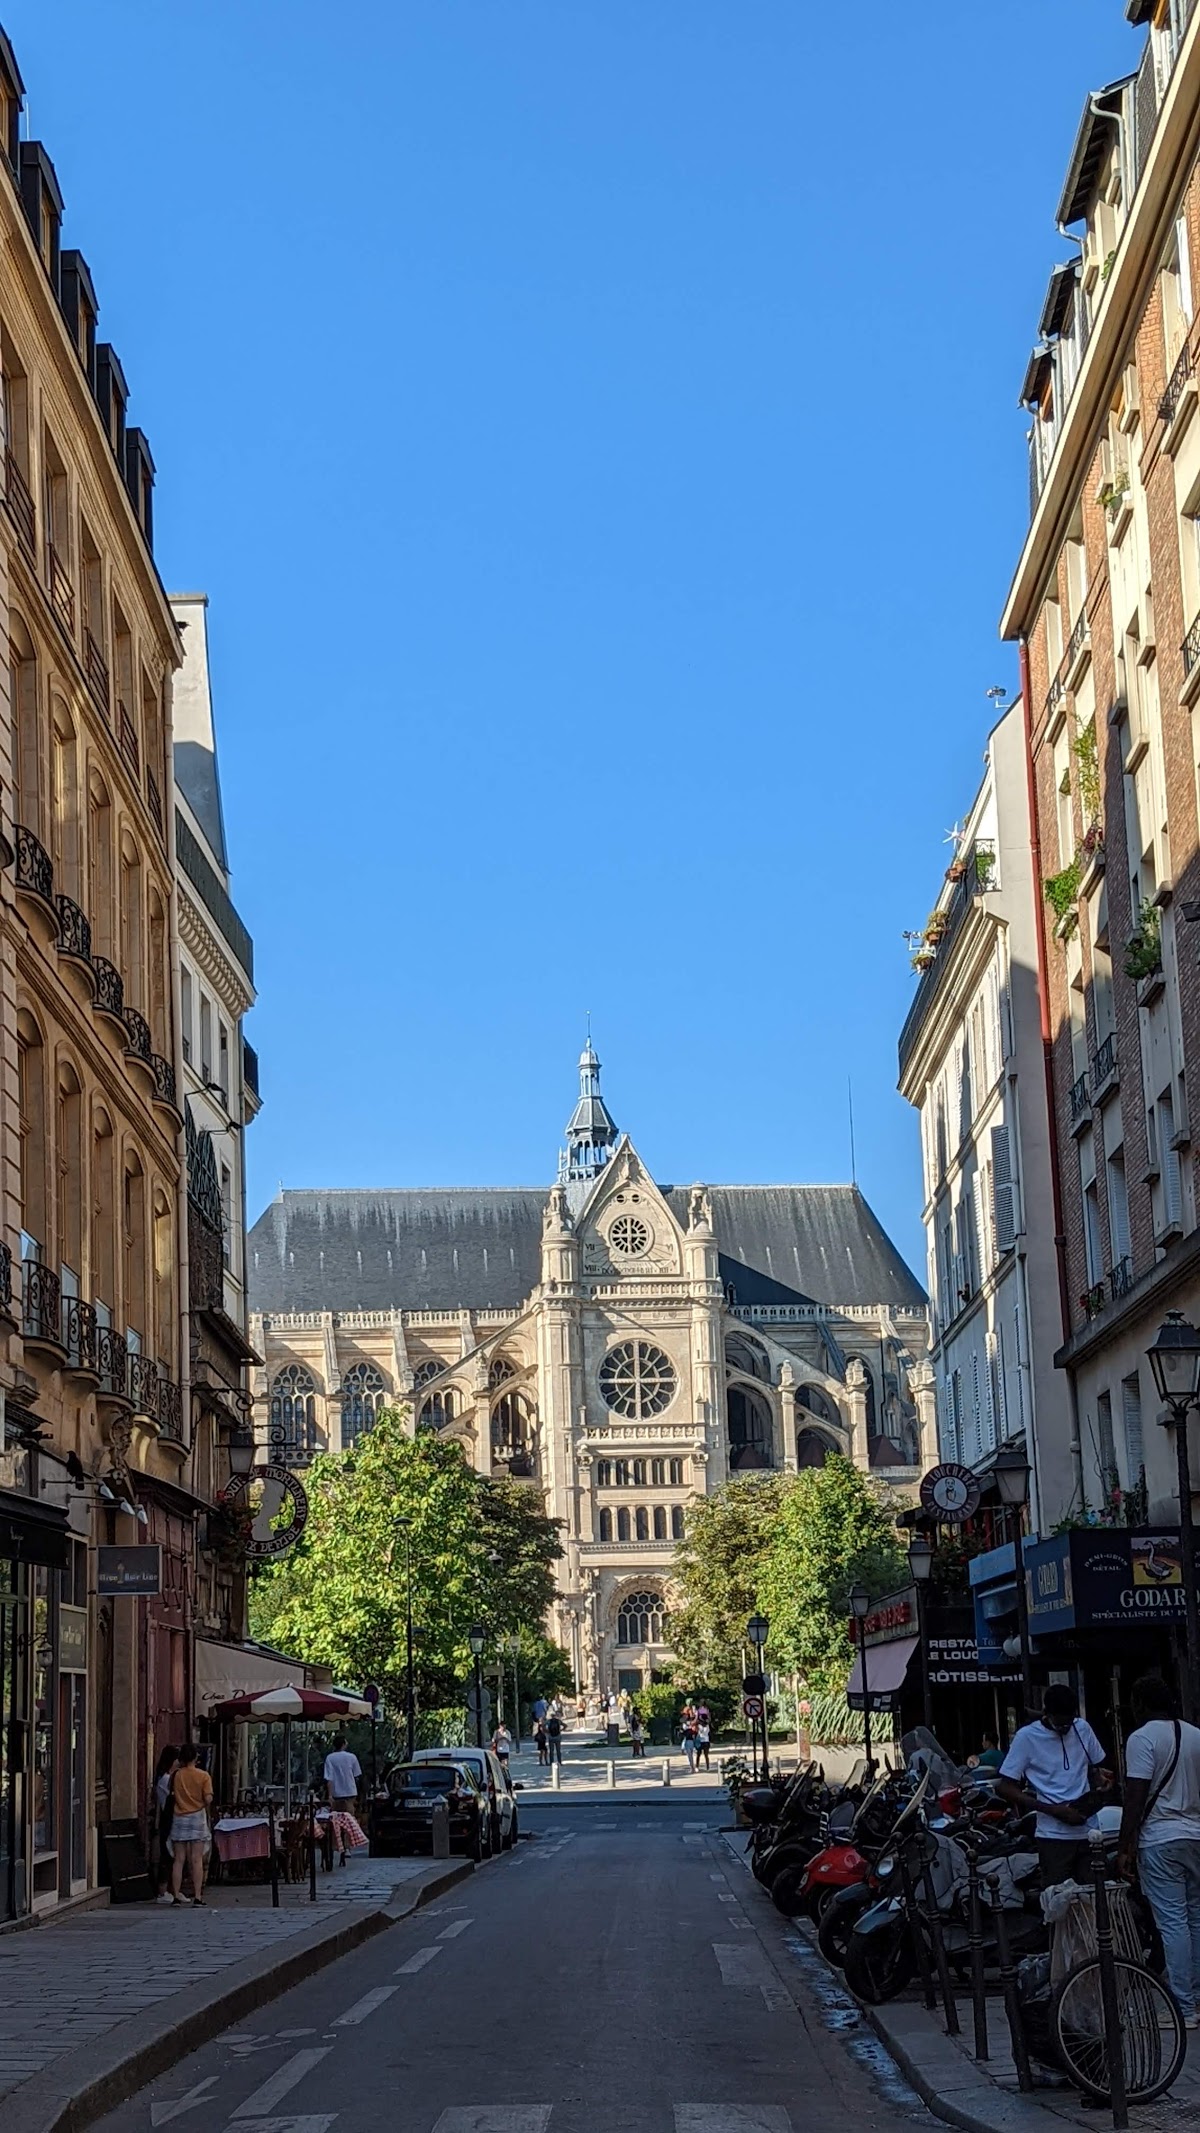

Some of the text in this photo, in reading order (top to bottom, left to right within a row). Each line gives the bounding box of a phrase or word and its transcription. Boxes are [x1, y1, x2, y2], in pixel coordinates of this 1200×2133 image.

[922, 1482, 934, 1495] LE
[1120, 1588, 1200, 1608] GODAR
[1091, 1609, 1157, 1620] SPÉCIALISTE
[928, 1651, 940, 1661] E
